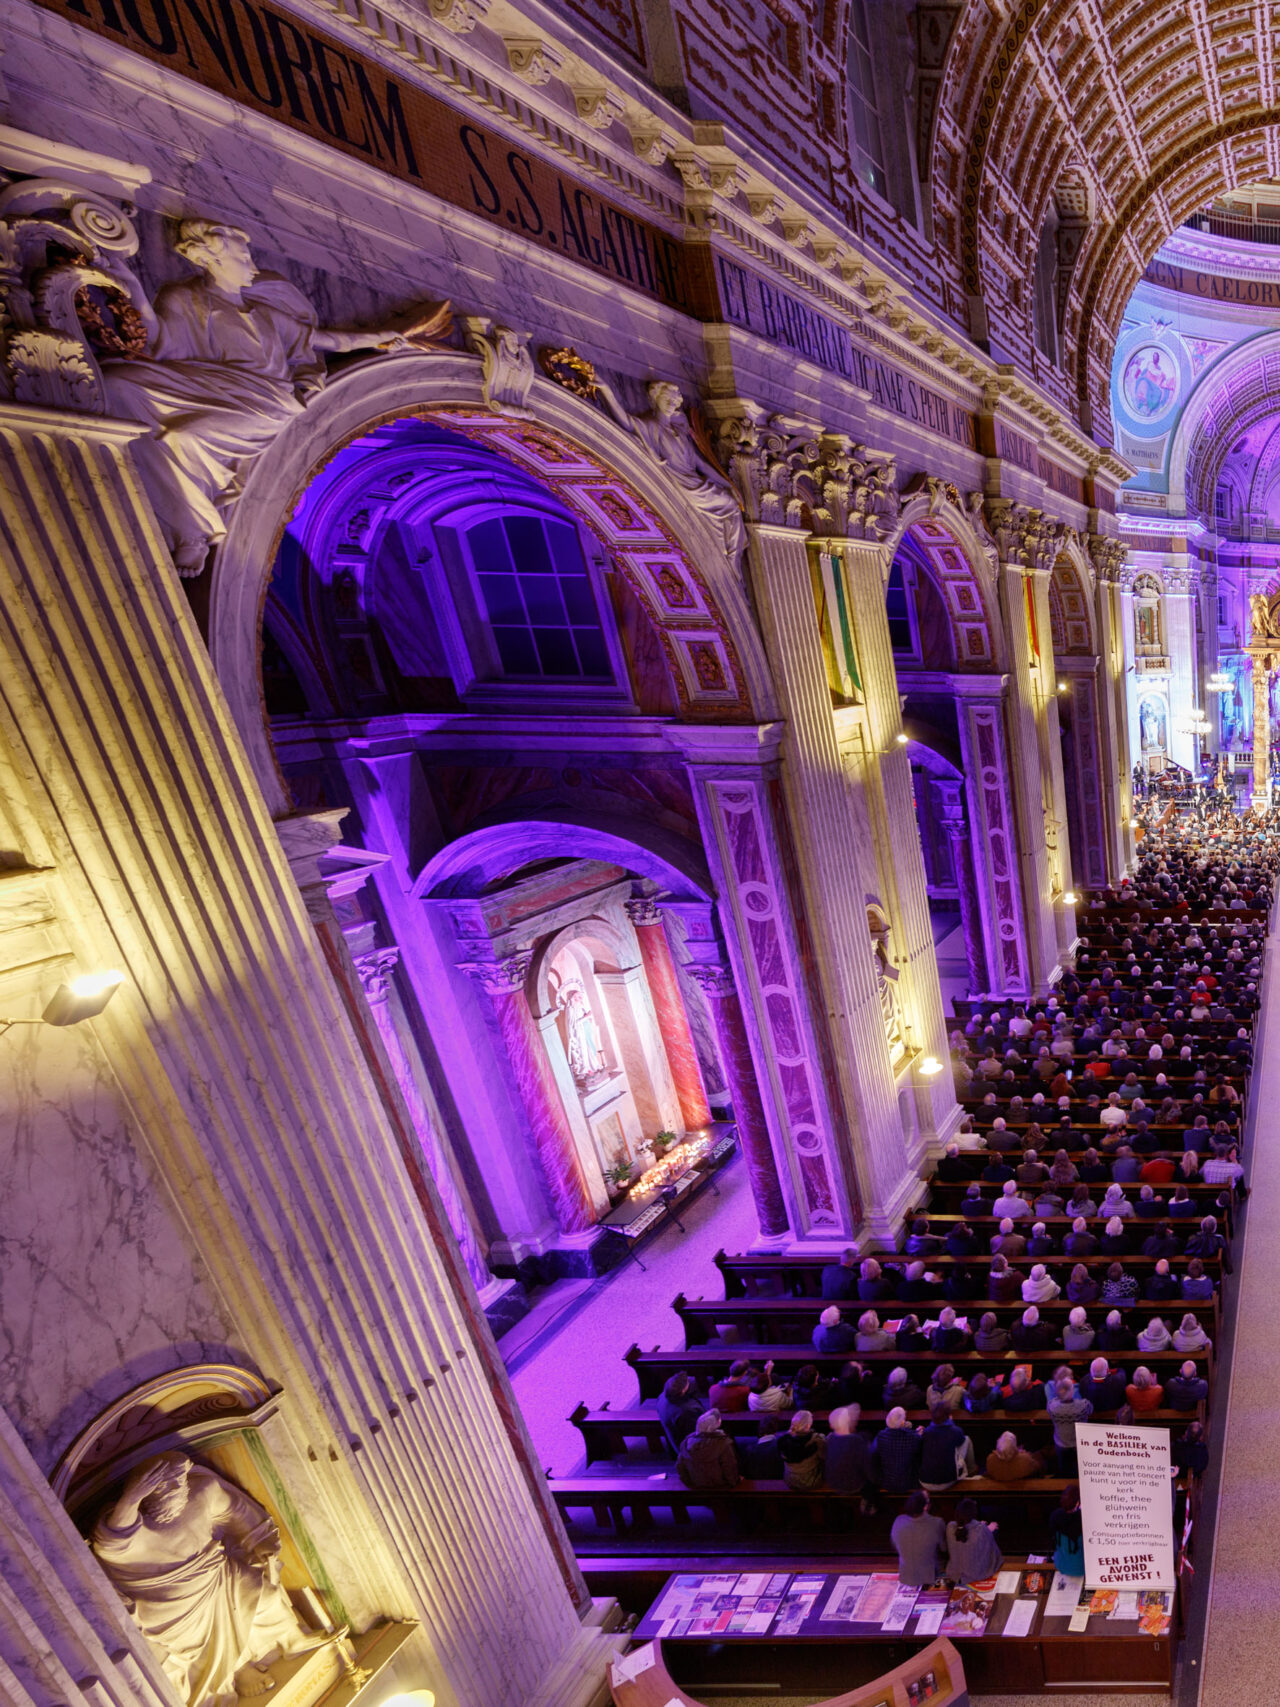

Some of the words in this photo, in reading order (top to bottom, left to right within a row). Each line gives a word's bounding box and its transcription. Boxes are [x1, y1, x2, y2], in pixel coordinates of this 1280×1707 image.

[718, 254, 751, 327] ET
[1106, 1432, 1141, 1440] Welkom
[1107, 1441, 1147, 1450] BASILIEK
[1098, 1448, 1151, 1458] Oudenbosch
[1103, 1462, 1134, 1470] aanvang
[1100, 1494, 1128, 1503] koffie,
[1092, 1531, 1164, 1539] Consumptiebonnen
[1098, 1557, 1119, 1566] EEN
[1123, 1554, 1155, 1564] FIJNE
[1109, 1564, 1147, 1574] AVOND
[1100, 1572, 1152, 1582] GEWENST
